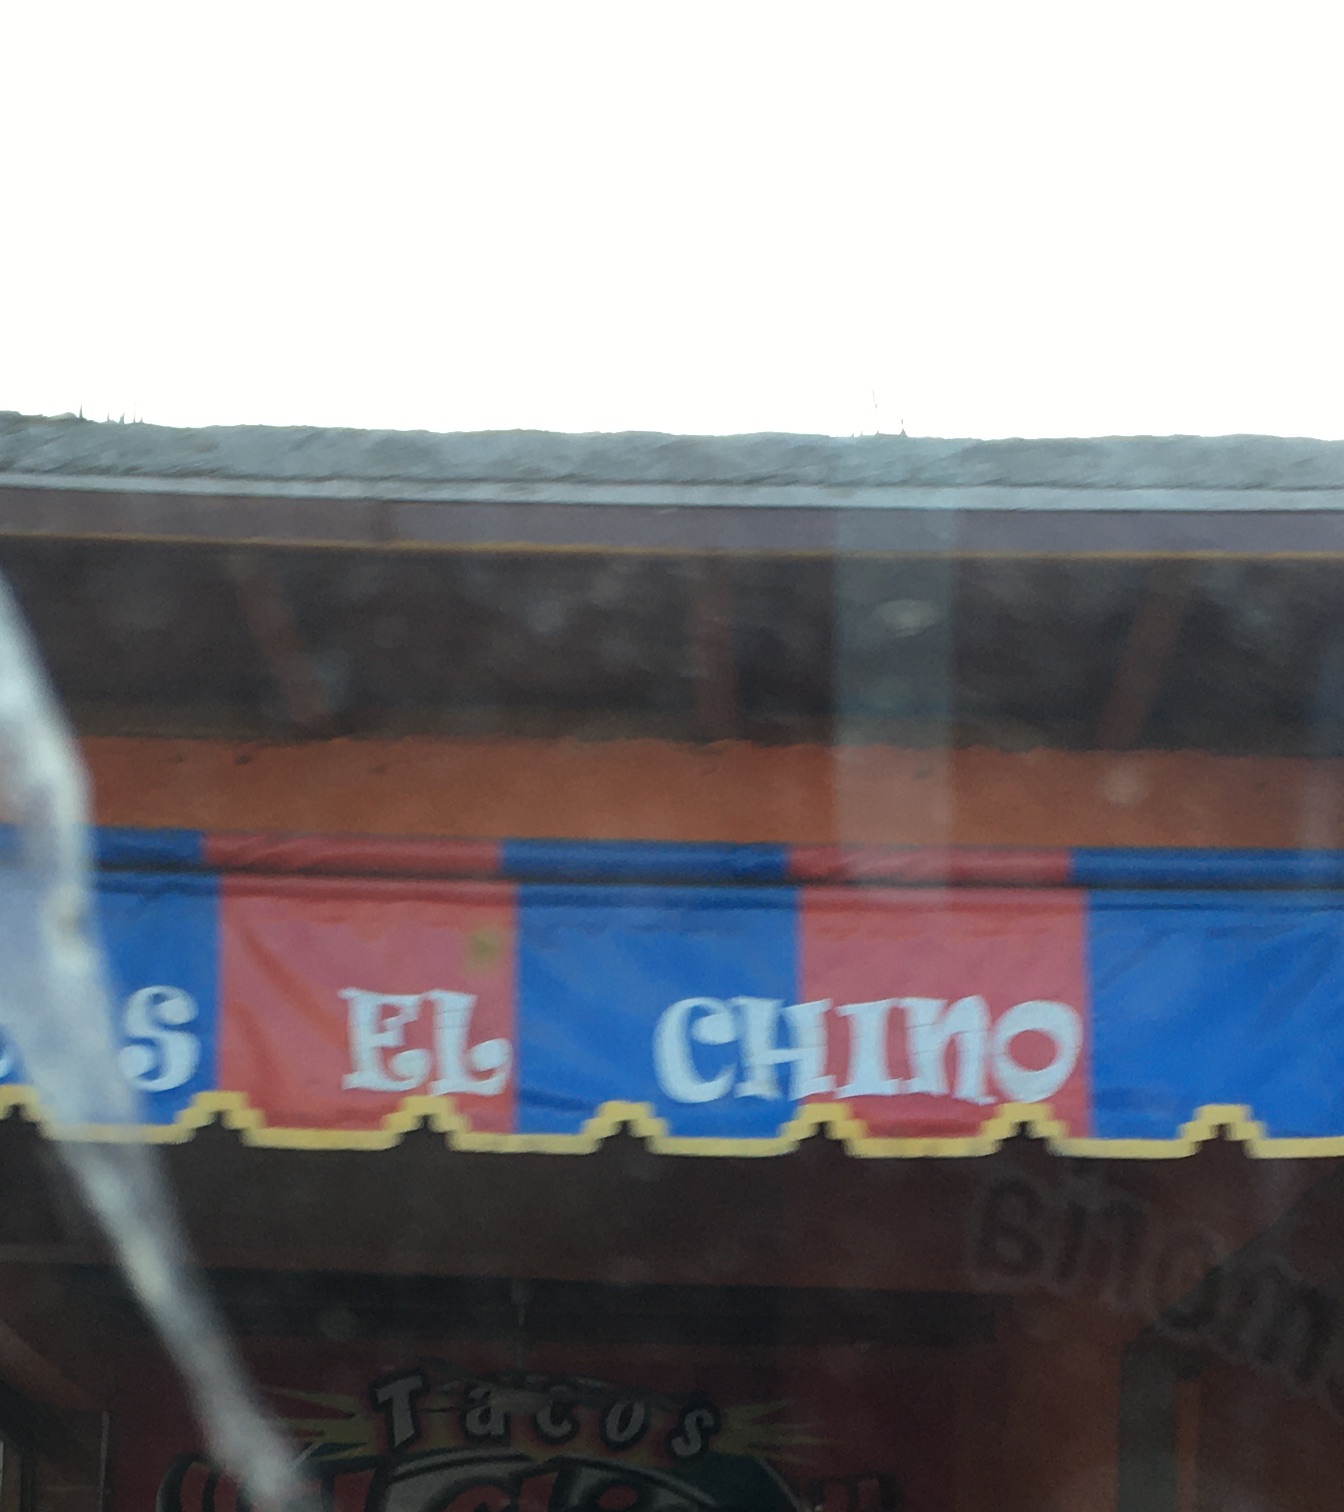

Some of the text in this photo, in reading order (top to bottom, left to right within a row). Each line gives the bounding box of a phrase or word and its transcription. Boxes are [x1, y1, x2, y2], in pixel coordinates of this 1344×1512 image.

[338, 987, 513, 1097] EL
[653, 995, 1084, 1105] CHINO
[376, 1374, 719, 1457] Tacos
